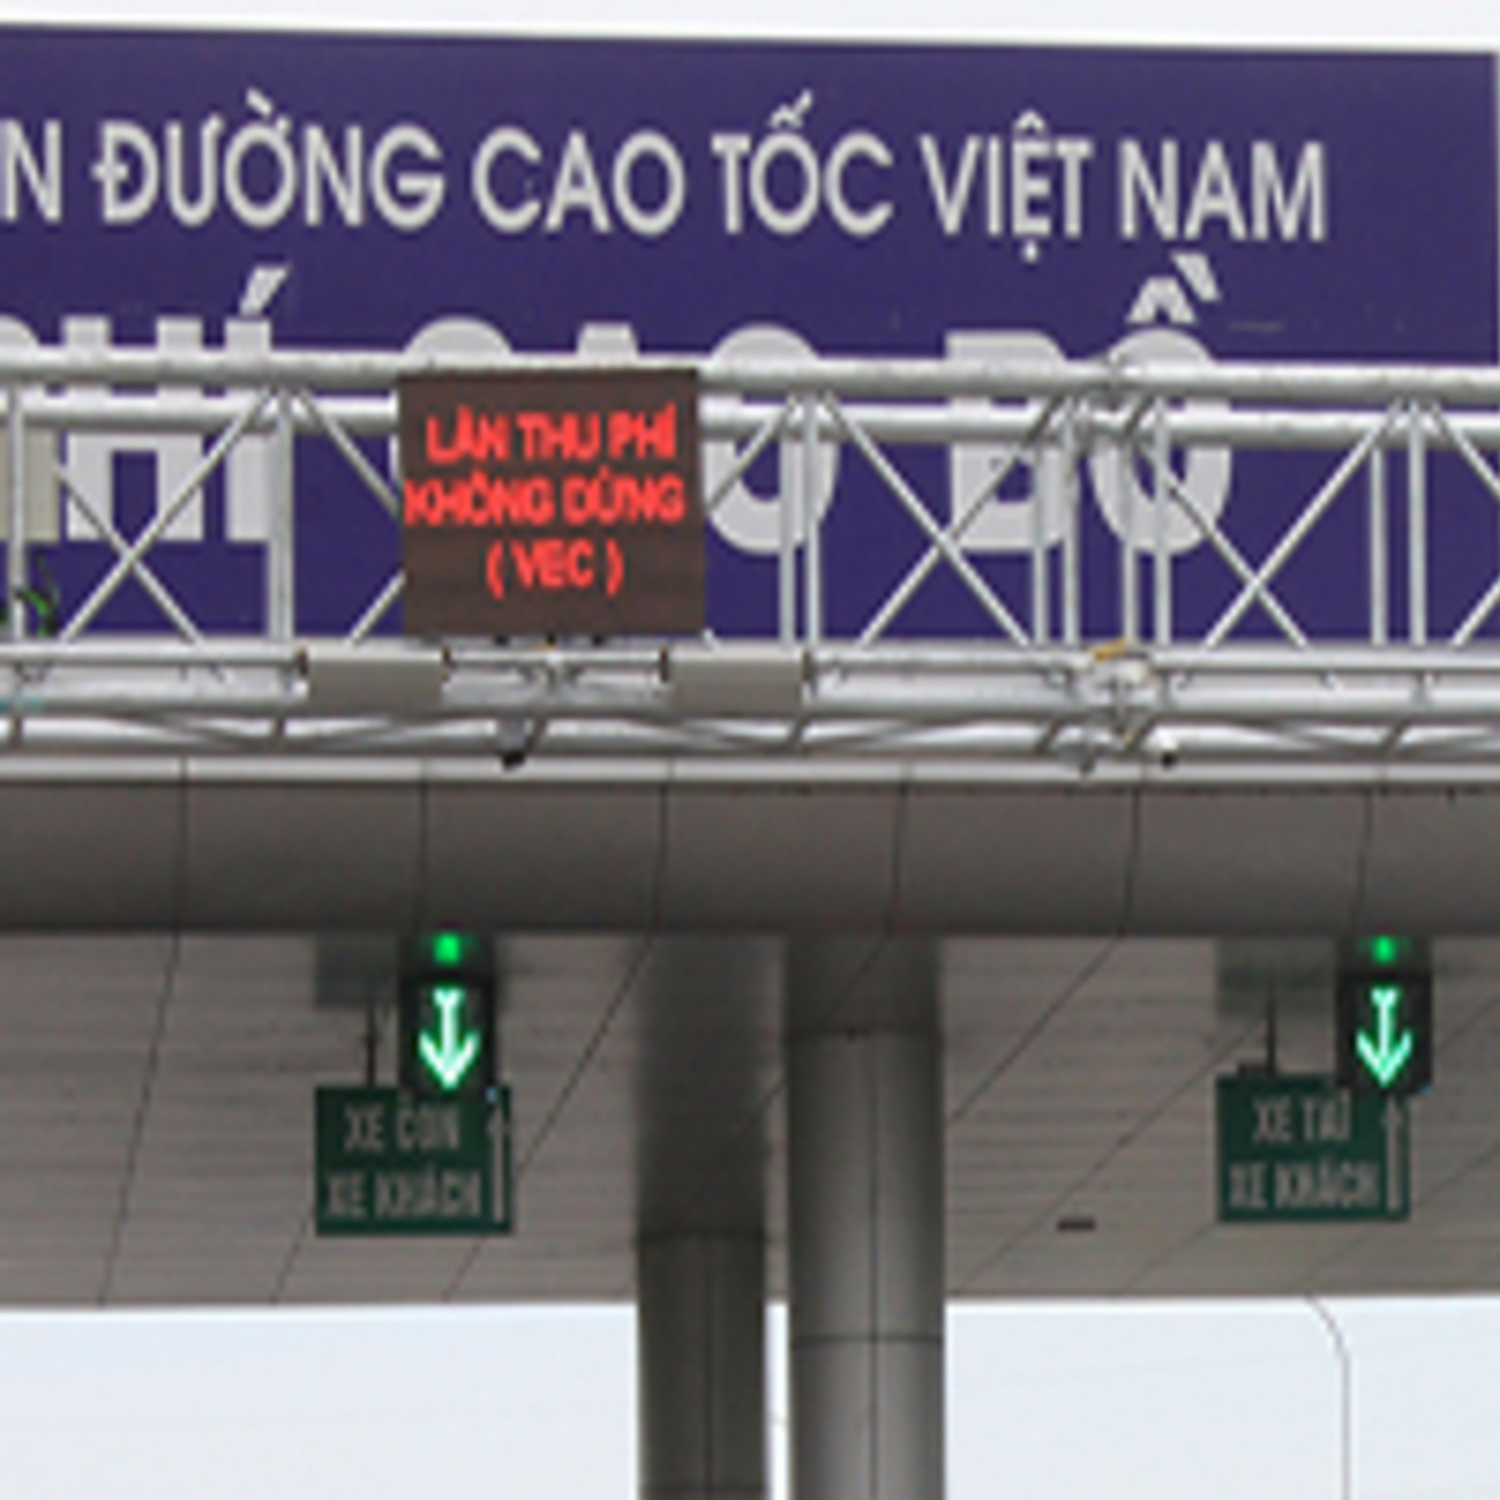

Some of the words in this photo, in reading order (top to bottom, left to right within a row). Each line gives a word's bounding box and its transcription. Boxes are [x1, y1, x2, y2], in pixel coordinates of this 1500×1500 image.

[93, 86, 446, 228] ĐƯỜNG
[471, 127, 686, 236] CAO
[711, 89, 893, 236] TỐC
[918, 108, 1093, 263] VIỆT
[1119, 138, 1328, 243] NAM
[516, 411, 601, 461] THU
[607, 402, 677, 459] PHÍ
[510, 538, 595, 590] VEC
